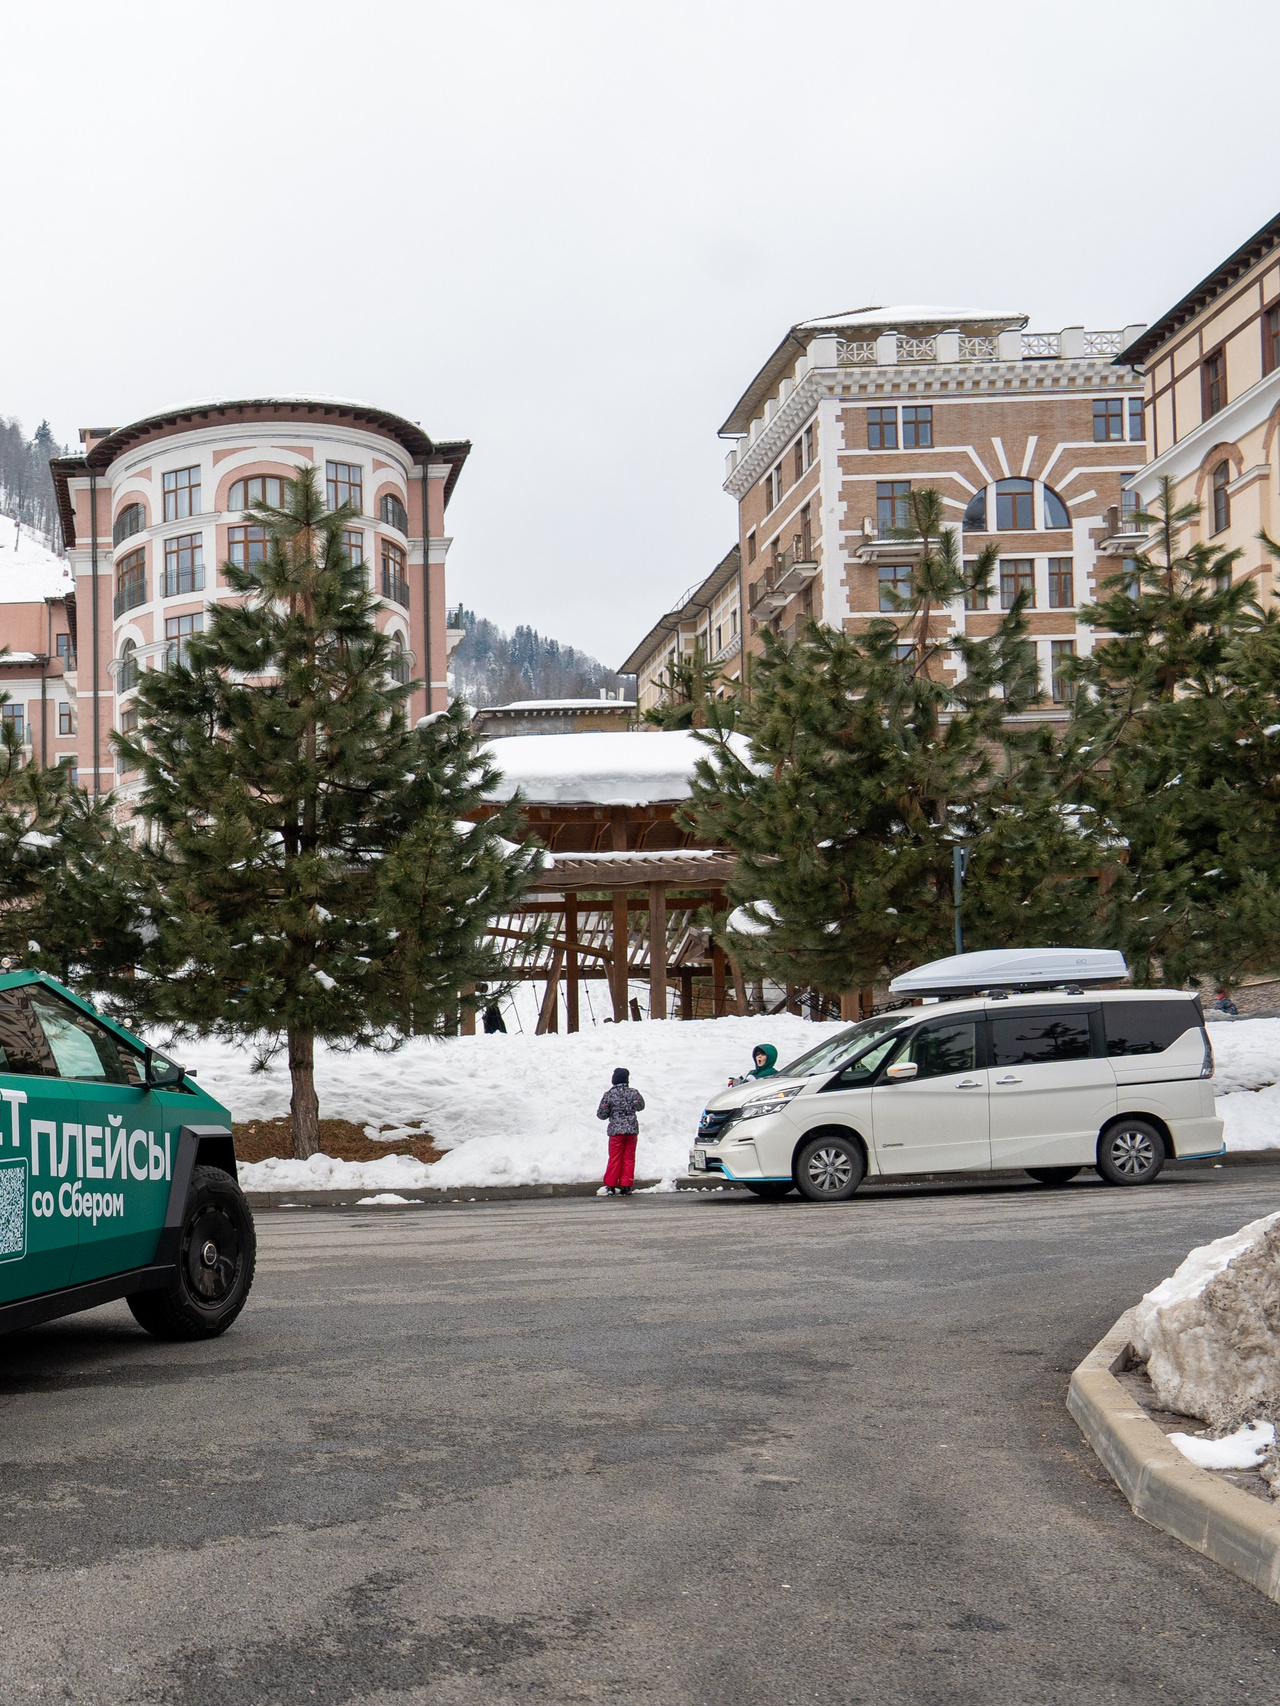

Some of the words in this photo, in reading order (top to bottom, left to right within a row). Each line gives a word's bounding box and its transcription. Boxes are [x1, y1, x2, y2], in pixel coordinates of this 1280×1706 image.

[30, 1114, 171, 1181] ПЛЕЙСЫ
[31, 1190, 54, 1218] со
[58, 1180, 125, 1227] Сбером
